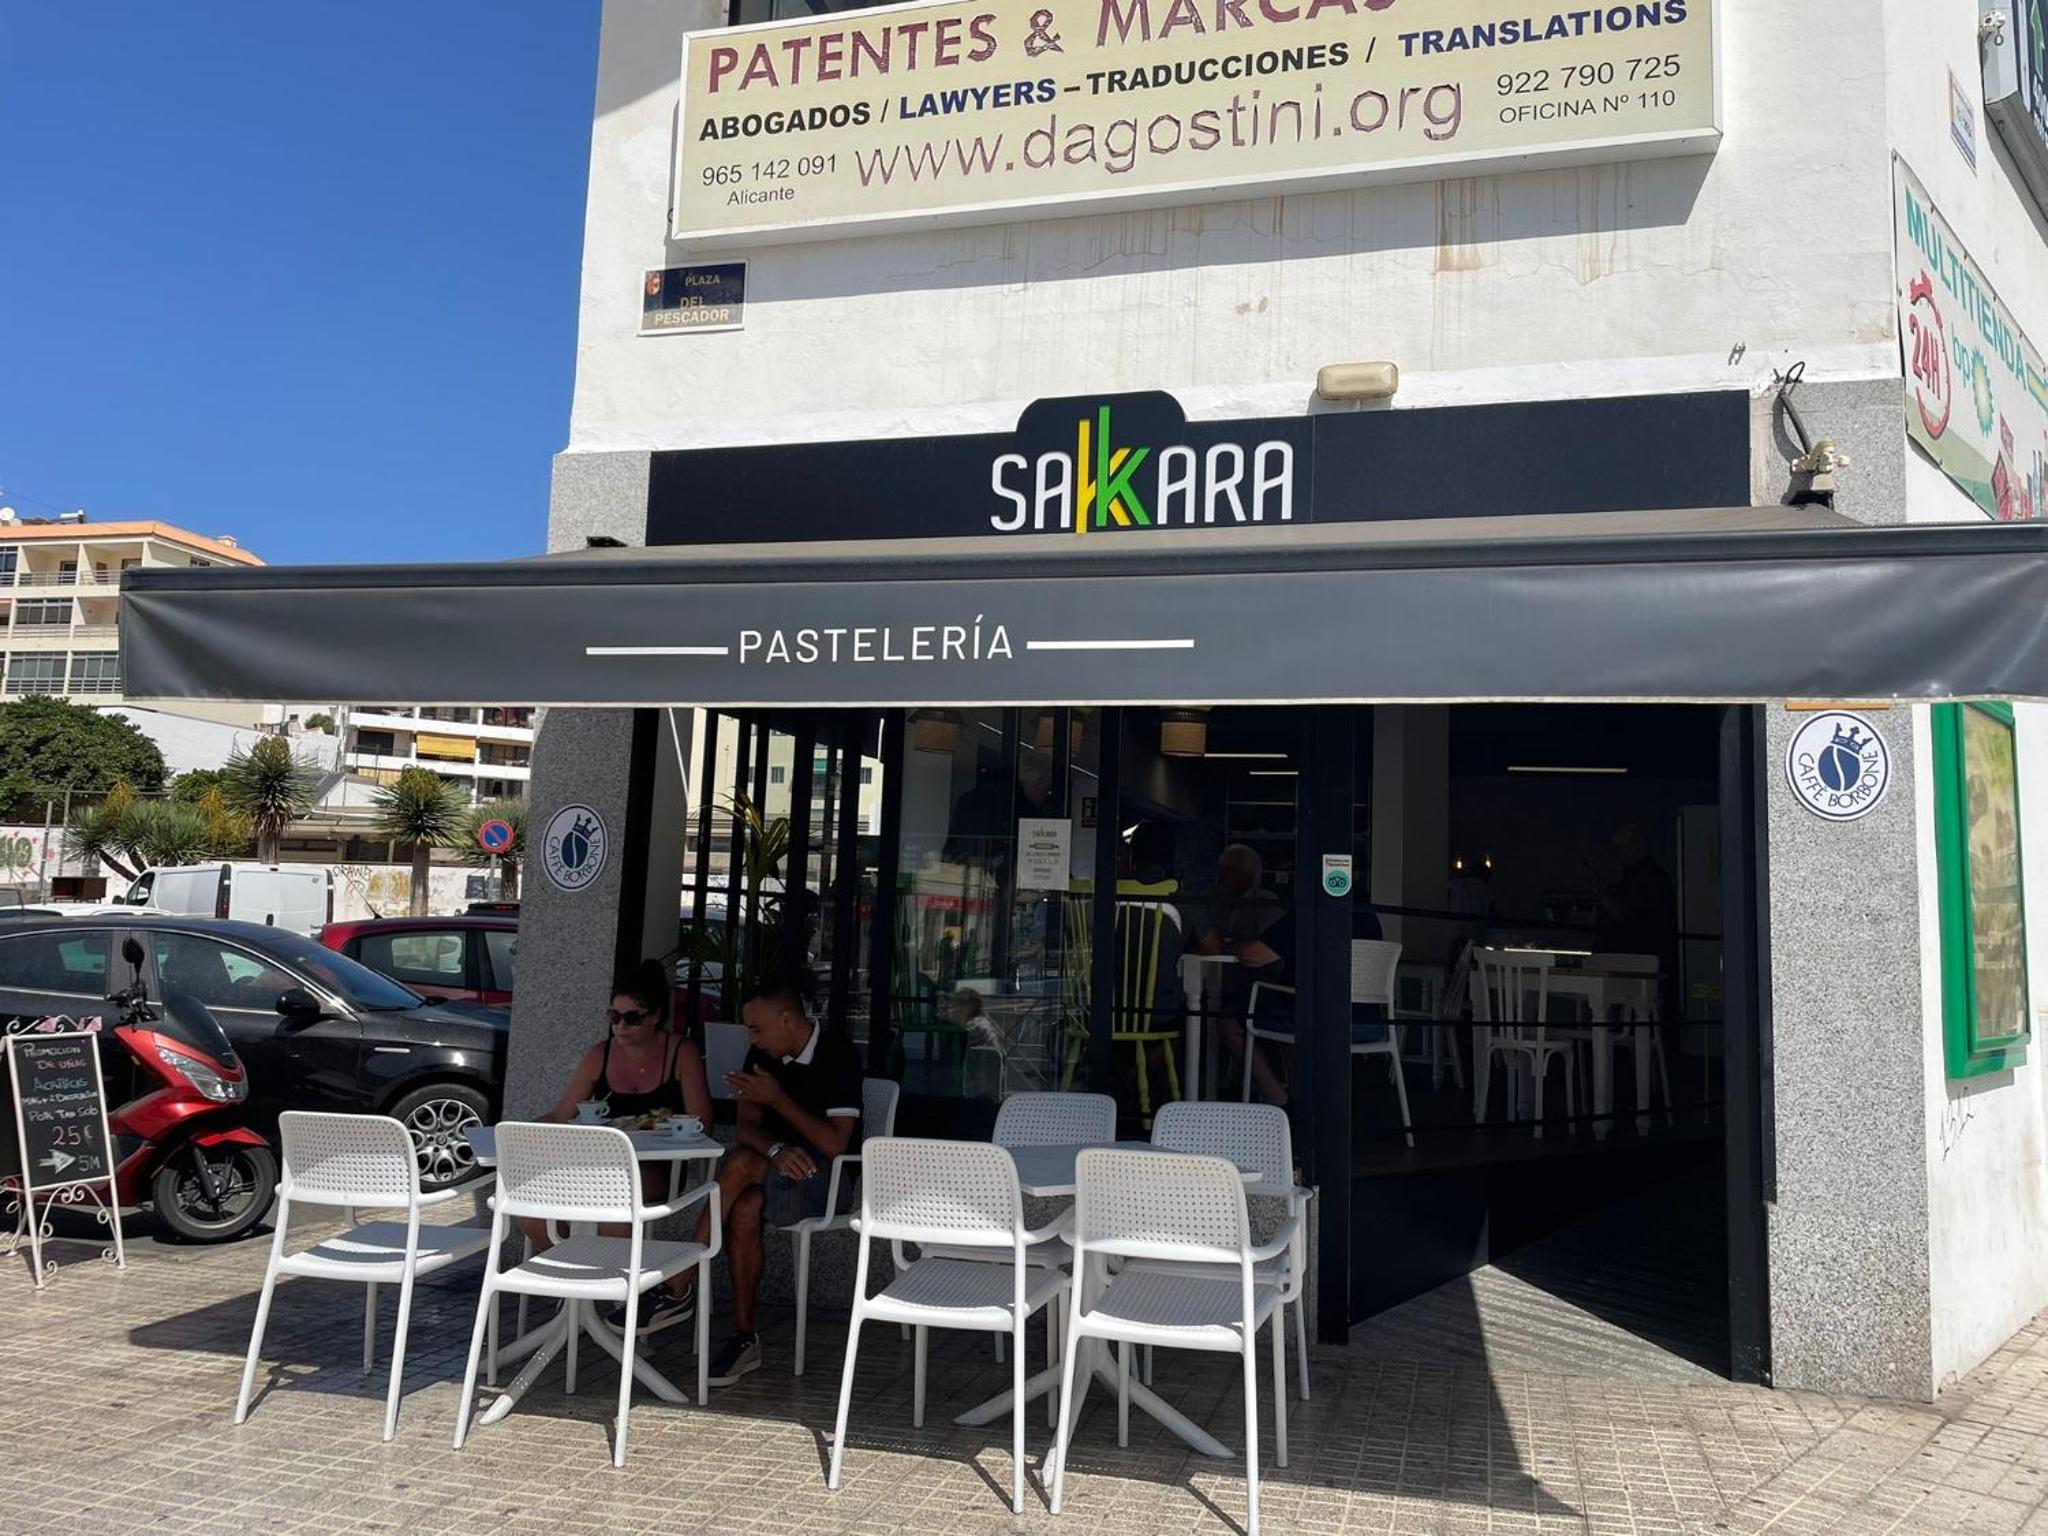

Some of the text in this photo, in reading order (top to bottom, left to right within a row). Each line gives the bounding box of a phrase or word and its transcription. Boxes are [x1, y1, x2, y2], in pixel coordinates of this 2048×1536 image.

[708, 0, 1398, 94] PATENTES & MARC
[699, 102, 871, 141] ABOGADOS
[899, 78, 1057, 120] LAWYERS
[1086, 42, 1349, 95] TRADUCCIONES
[1398, 0, 1688, 57] TRANSLATIONS
[1497, 54, 1681, 96] 922 790 725
[1499, 101, 1597, 124] OFICINA
[1639, 89, 1676, 109] 110
[855, 83, 1463, 189] www.dagostini.org
[702, 153, 837, 187] 965 142 091
[727, 186, 796, 206] Alicante
[681, 296, 706, 308] DEL
[685, 275, 720, 286] PLAZA
[1905, 184, 2027, 393] MULTITIENDA
[655, 308, 730, 325] PESCADOR
[1909, 312, 1941, 401] 24H
[738, 614, 1013, 664] PASTELERÍA
[1827, 750, 1880, 808] BORBONE
